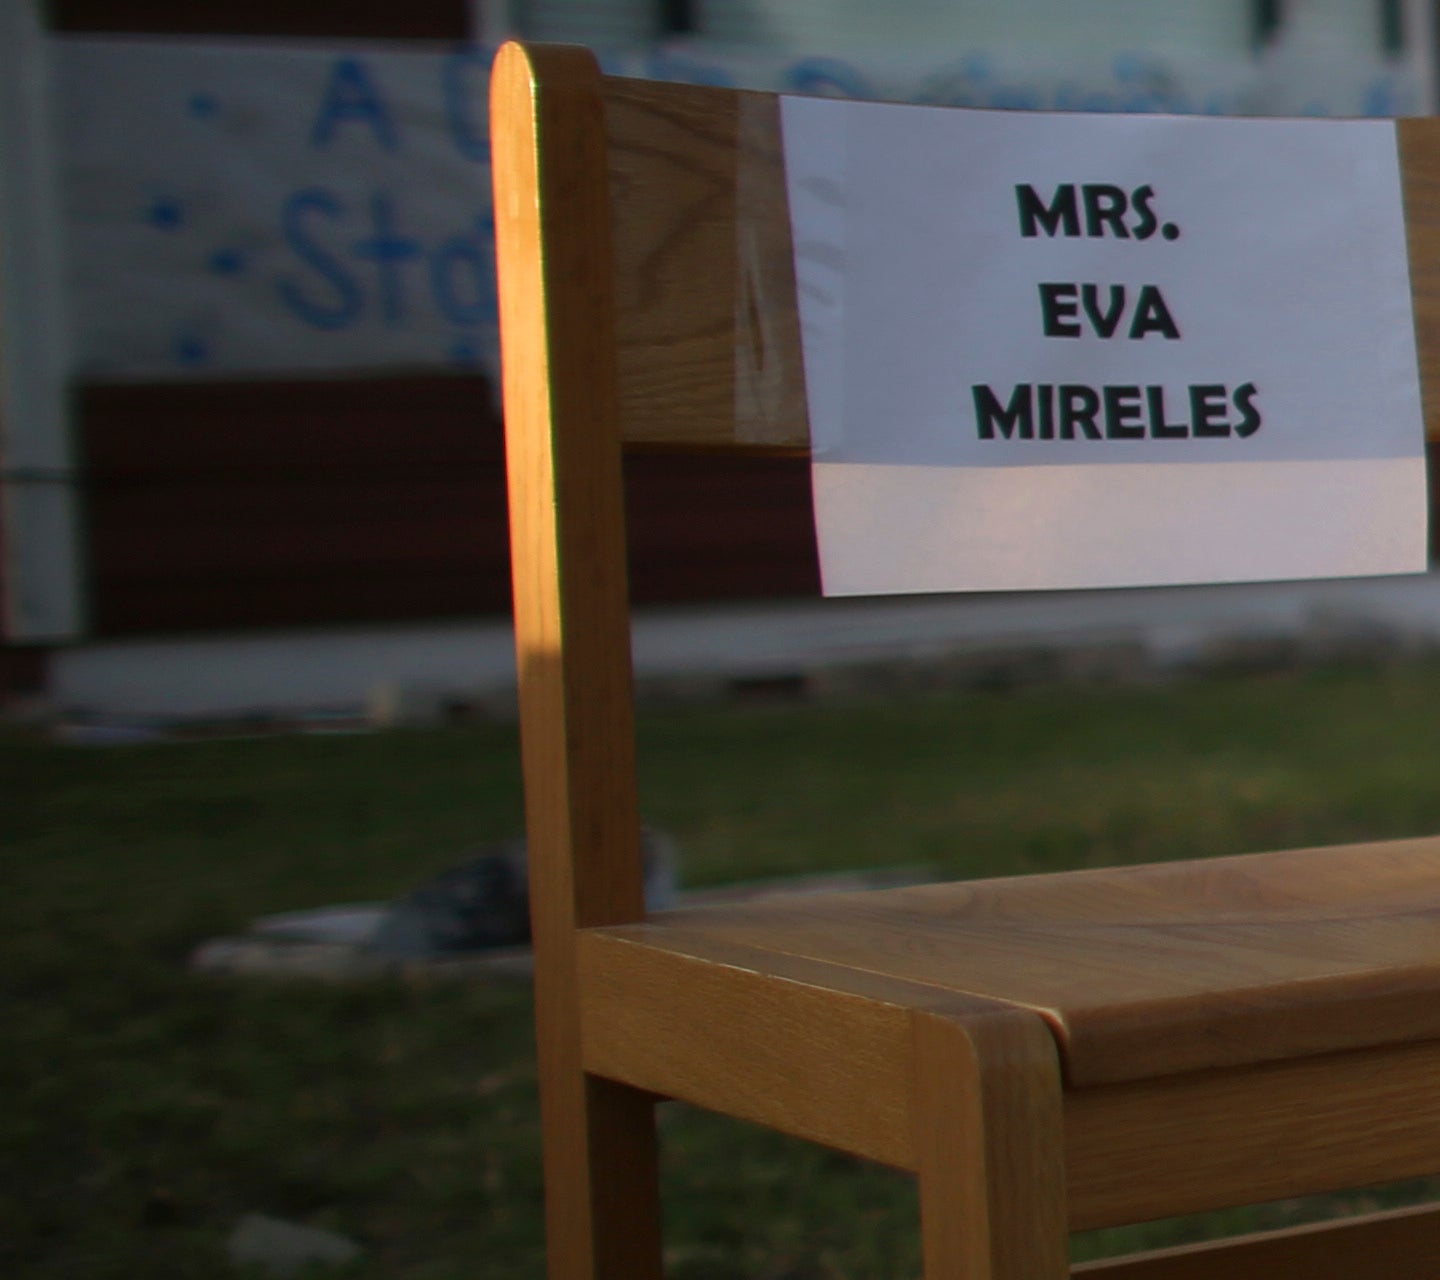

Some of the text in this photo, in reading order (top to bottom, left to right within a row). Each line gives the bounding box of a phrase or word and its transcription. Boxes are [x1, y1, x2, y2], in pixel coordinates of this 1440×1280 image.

[1015, 183, 1180, 241] MRS.
[1038, 282, 1181, 341] EVA
[971, 382, 1262, 441] MIRELES
